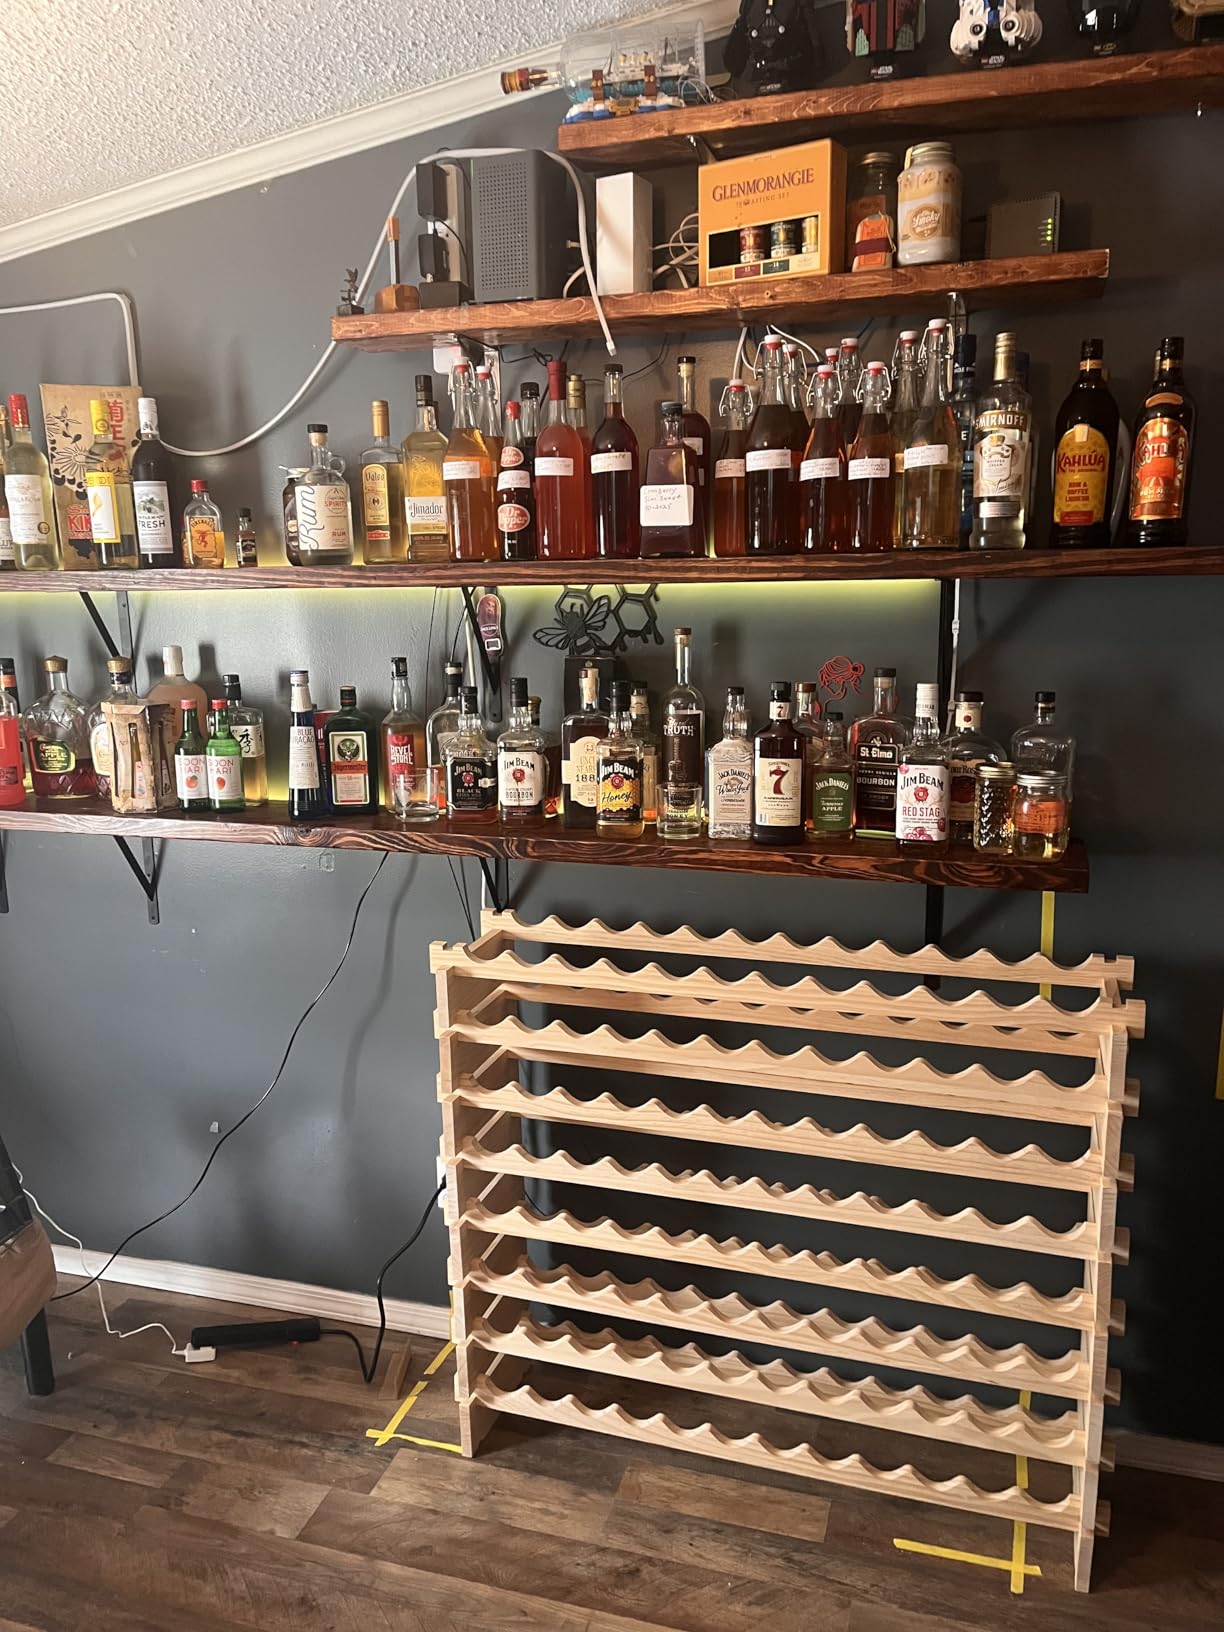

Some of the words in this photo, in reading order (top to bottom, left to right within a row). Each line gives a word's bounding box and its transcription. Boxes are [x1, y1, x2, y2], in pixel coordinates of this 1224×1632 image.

[712, 168, 815, 202] GLENMORANGIE
[975, 414, 1025, 430] SMIRNOFF
[1056, 450, 1105, 473] KAHLÚA
[411, 502, 443, 518] Jimador
[505, 507, 520, 517] Dr
[776, 704, 784, 718] 7
[297, 728, 313, 736] BLUE
[663, 725, 694, 737] TRUTH
[860, 746, 870, 758] St
[871, 747, 893, 759] Elmo
[454, 765, 465, 776] JIM
[466, 763, 482, 775] BEAM
[504, 760, 515, 770] JIM
[516, 757, 535, 771] BEAM
[600, 765, 613, 780] JIM
[613, 762, 634, 778] BEAM
[718, 771, 730, 780] JACK
[575, 774, 596, 782] 188
[769, 769, 790, 796] 7
[856, 777, 895, 787] BOURBON
[901, 775, 917, 791] JIM
[918, 772, 944, 792] BEAM
[716, 784, 738, 795] Winter
[815, 780, 829, 791] JACK
[505, 791, 534, 799] BOURBON
[601, 791, 632, 803] Honey
[902, 806, 917, 817] RED
[919, 806, 940, 818] STAG
